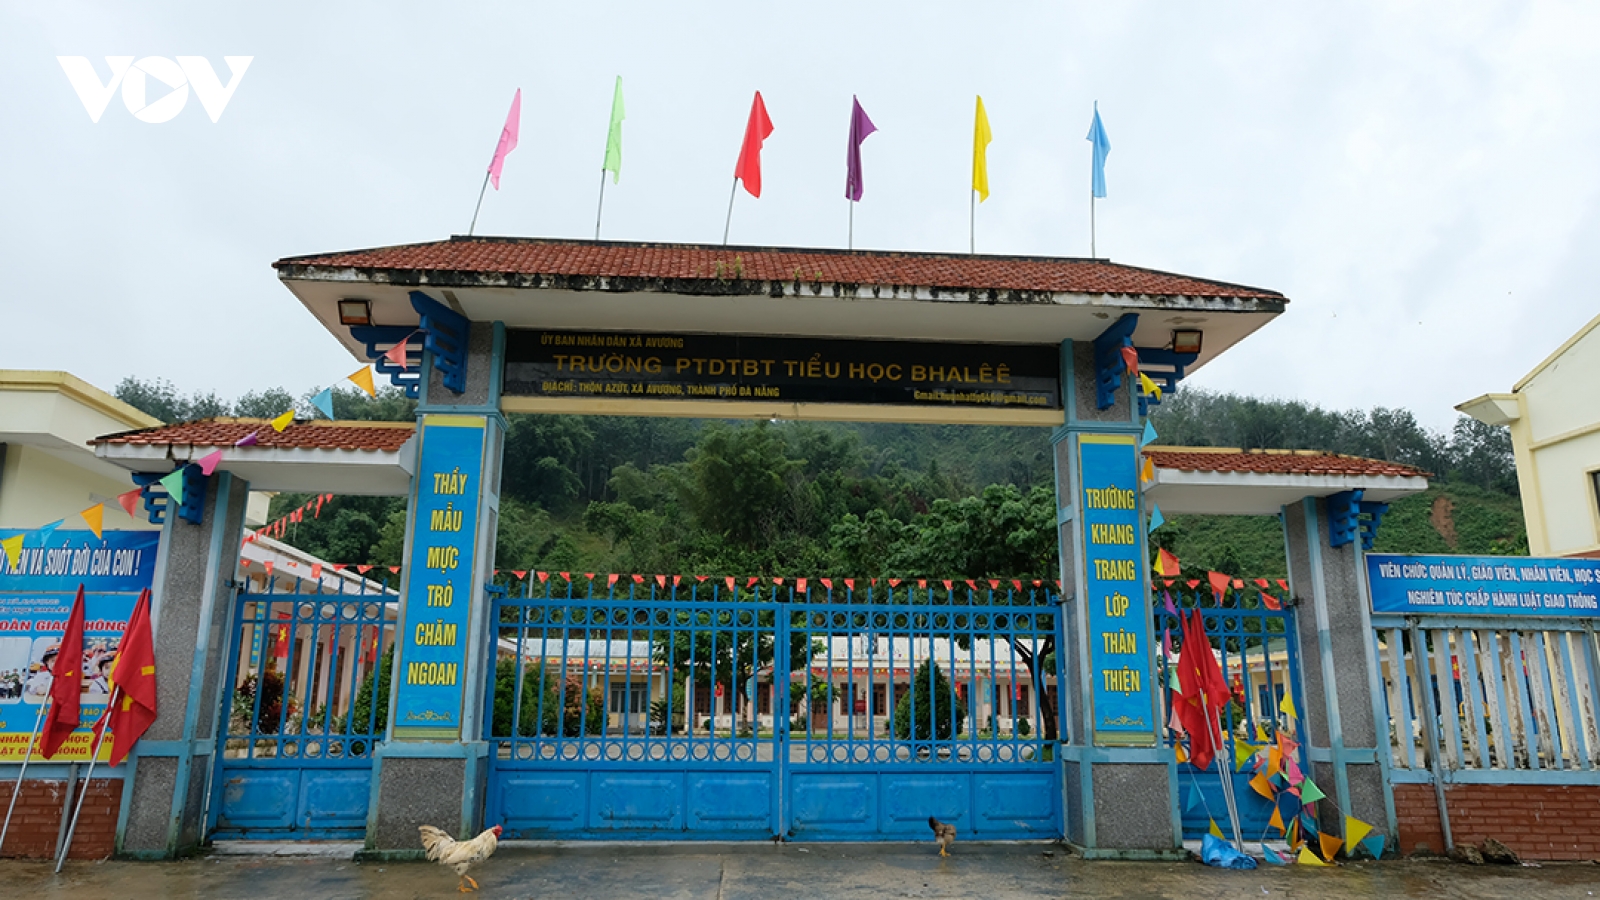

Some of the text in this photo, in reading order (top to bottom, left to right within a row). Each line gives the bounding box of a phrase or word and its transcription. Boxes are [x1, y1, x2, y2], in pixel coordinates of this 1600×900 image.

[555, 335, 576, 346] BAN
[577, 335, 605, 347] NHÂN
[606, 336, 628, 348] DÂN
[552, 352, 1012, 384] TRƯỜNG PTDTBT TIỂU HỌC BHALÊÊ
[579, 381, 603, 393] THÔN
[687, 383, 716, 396] THÀNH
[719, 383, 738, 397] PHỐ
[1085, 484, 1135, 510] TRƯỜNG
[430, 501, 463, 532] MẪU
[1090, 523, 1134, 545] KHANG
[44, 539, 73, 576] SUỐT
[71, 542, 91, 576] ĐỜI
[91, 540, 112, 576] CỦA
[112, 549, 136, 576] CON
[426, 546, 459, 574] MỰC
[1094, 559, 1136, 581] TRANG
[1378, 561, 1401, 578] VIÊN
[1402, 561, 1428, 579] CHỨC
[1429, 561, 1455, 581] QUẢN
[1472, 562, 1494, 580] GIÁO
[1520, 564, 1548, 582] NHÂN
[1573, 568, 1594, 586] HỌC
[427, 579, 453, 607] TRÒ
[1105, 591, 1129, 617] LỚP
[1407, 587, 1598, 610] NGHIÊM TÚC CHẤP HÀNH LUẬT GIAO THÔNG
[84, 618, 127, 631] HÔNG
[415, 618, 457, 646] CHĂM
[1102, 628, 1137, 654] THÂN
[406, 661, 458, 686] NGOAN
[1102, 665, 1141, 697] THIỆN
